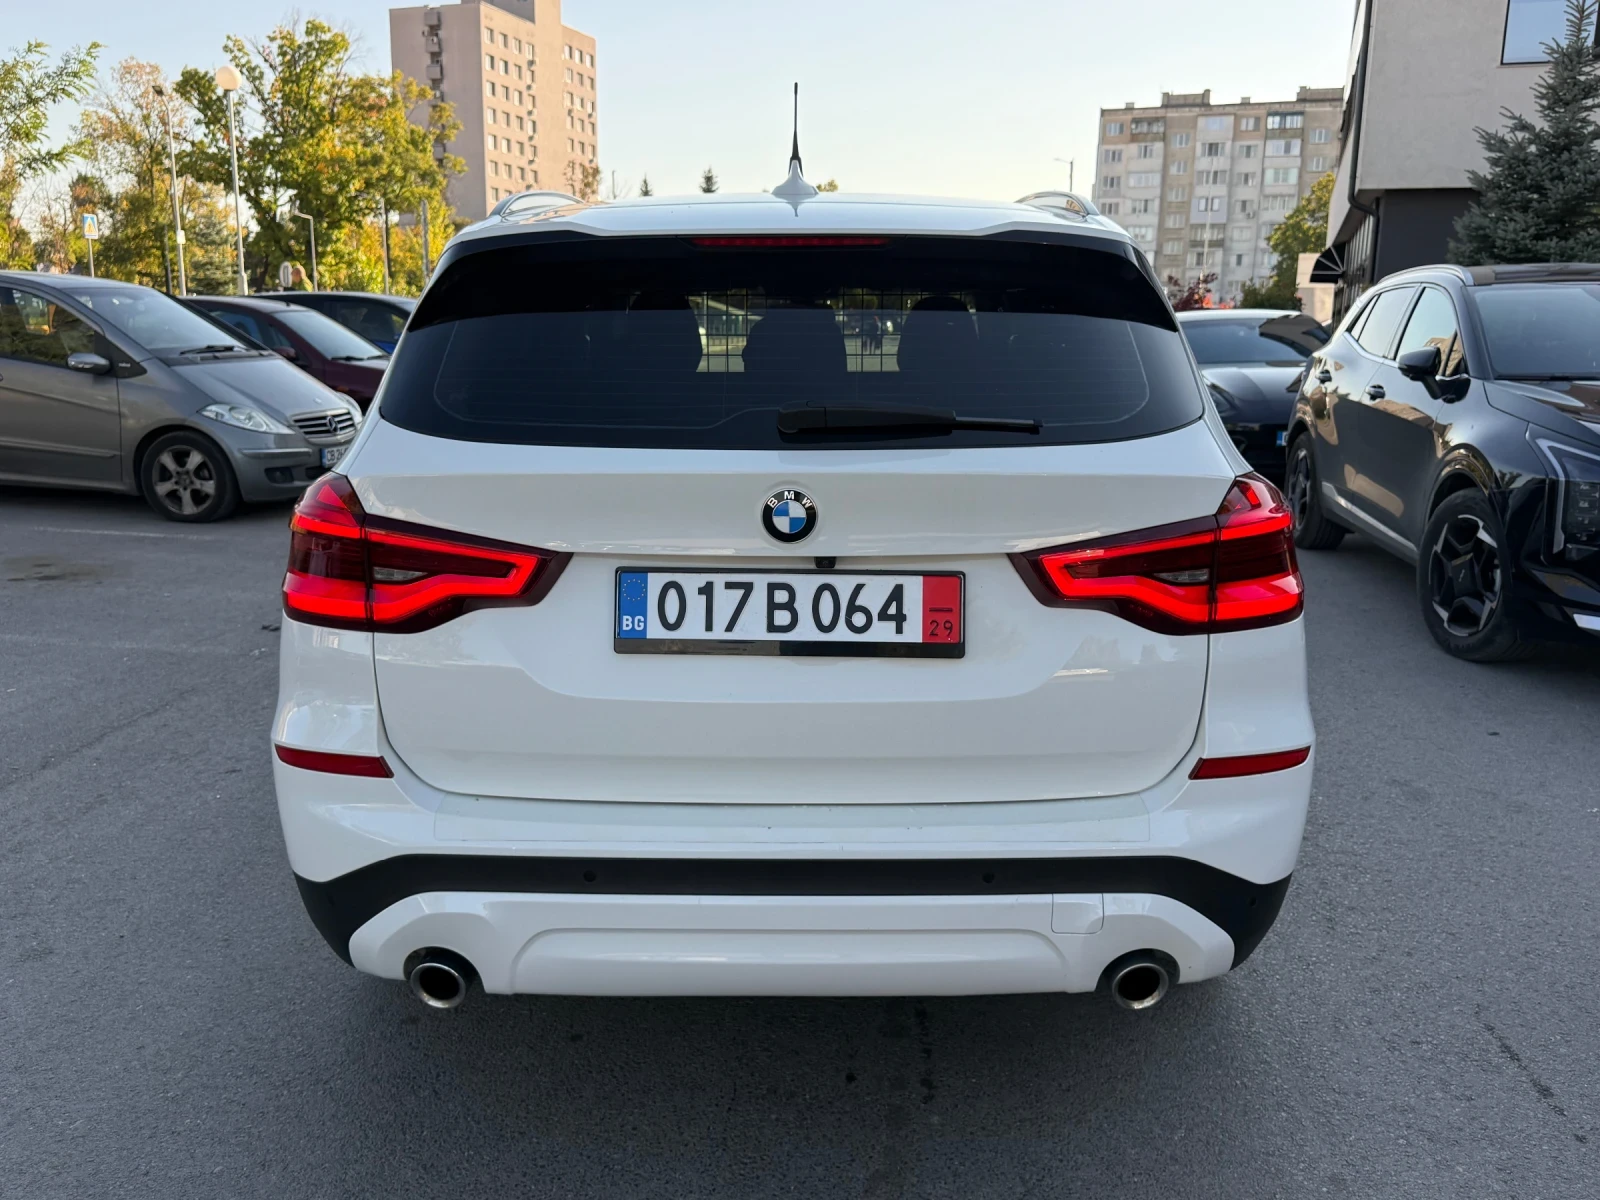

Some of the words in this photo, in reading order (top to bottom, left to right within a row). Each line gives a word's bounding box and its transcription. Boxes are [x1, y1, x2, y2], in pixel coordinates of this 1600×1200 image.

[767, 490, 813, 508] BMW
[622, 615, 645, 631] BG
[928, 619, 954, 637] 29
